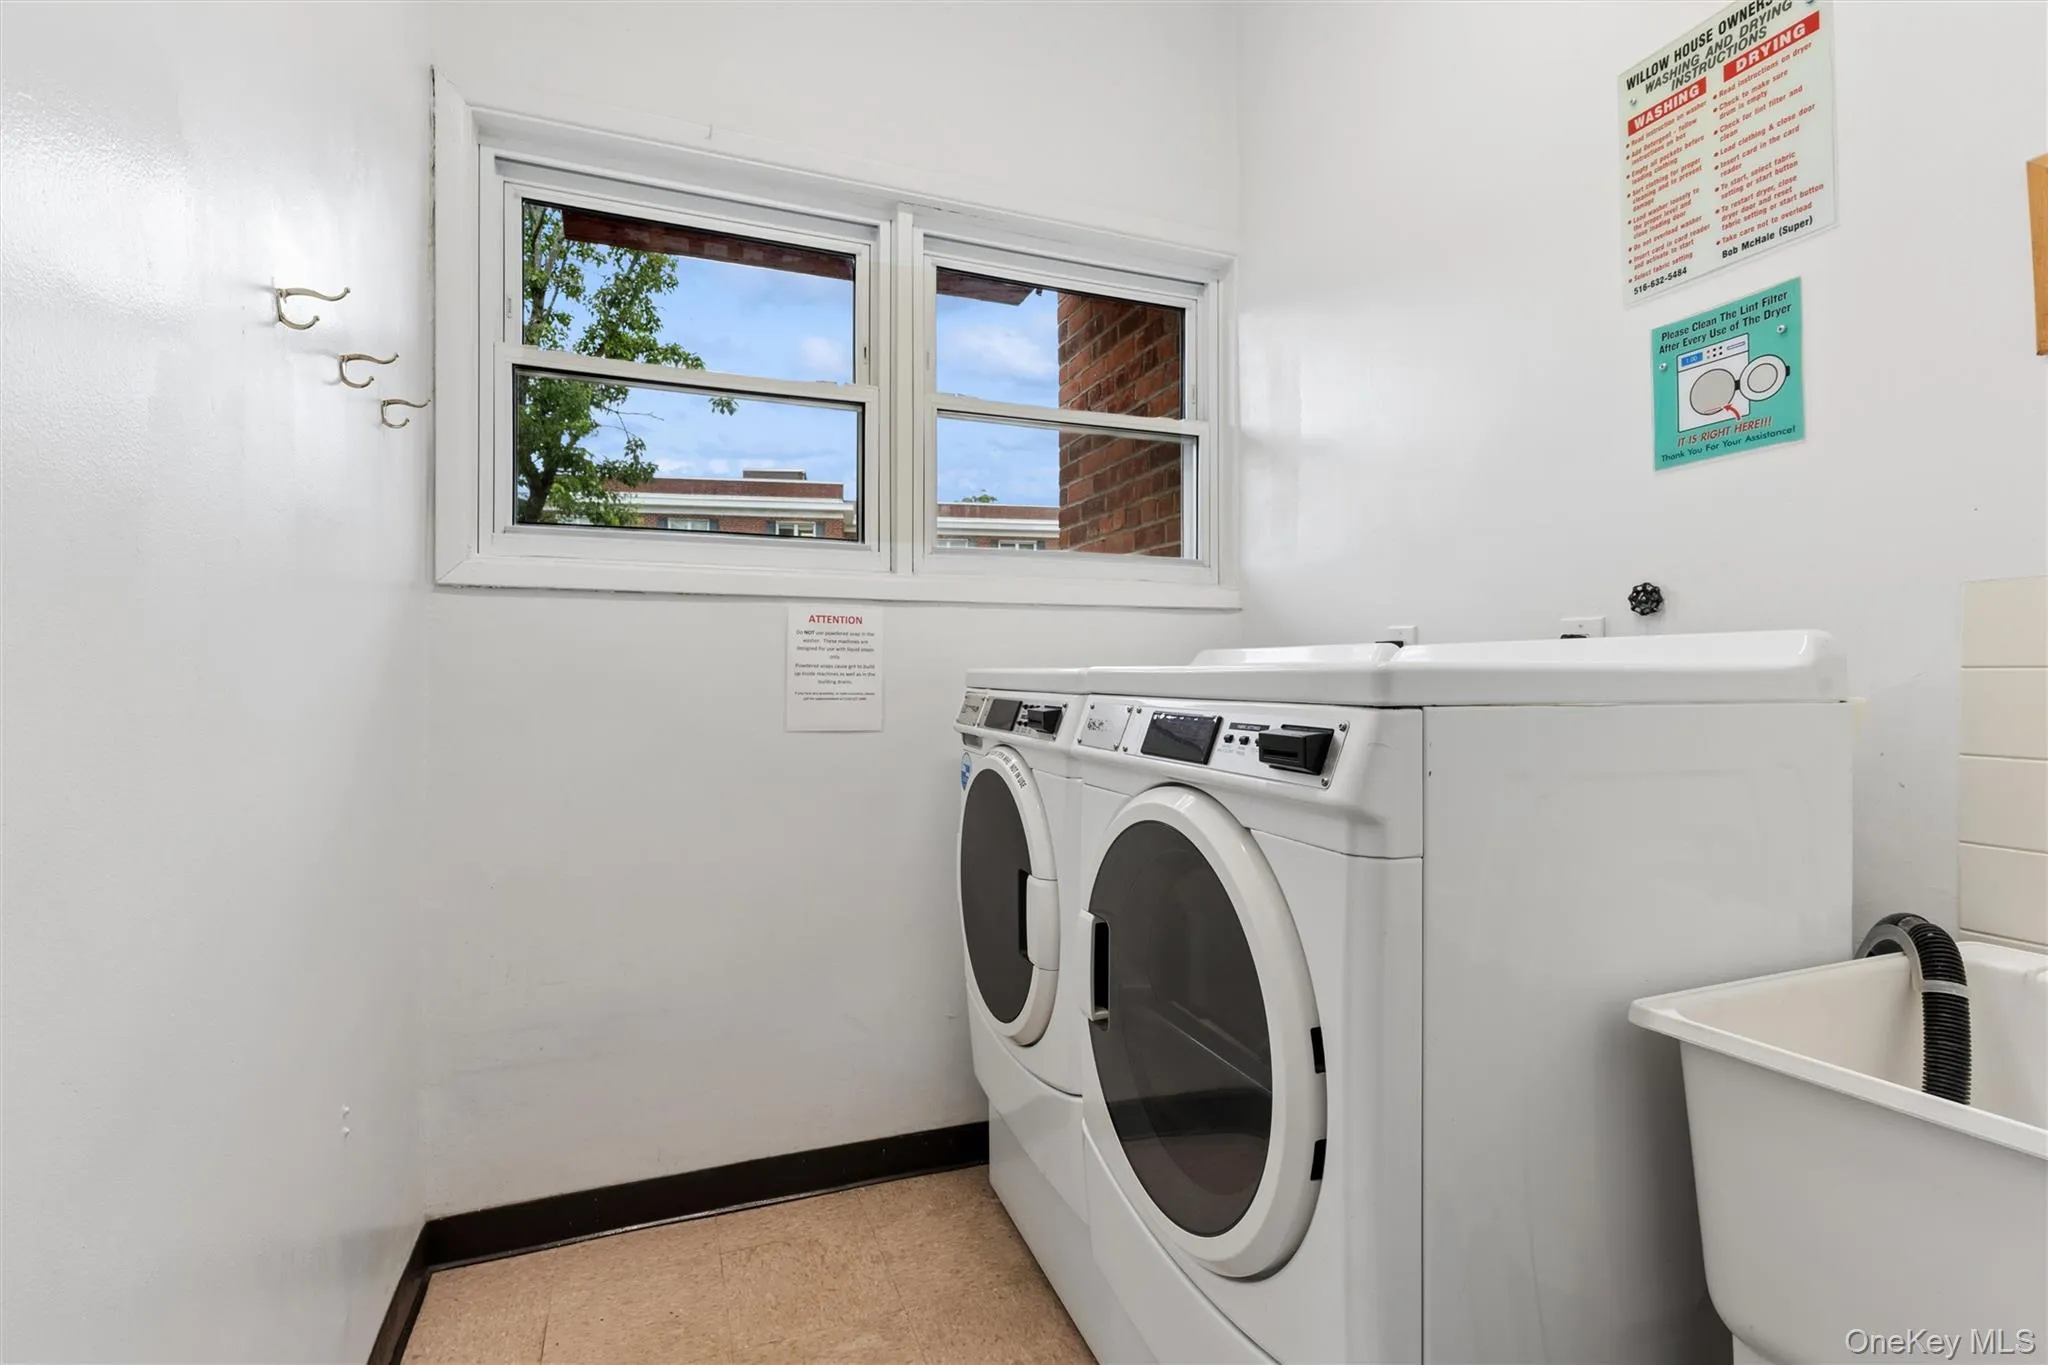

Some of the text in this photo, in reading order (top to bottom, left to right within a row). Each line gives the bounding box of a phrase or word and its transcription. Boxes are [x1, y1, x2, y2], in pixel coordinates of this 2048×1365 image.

[1626, 53, 1669, 92] WILLOW
[1674, 26, 1713, 63] HOUSE
[1645, 0, 1792, 94] WASHING AND DRYING
[1671, 24, 1767, 91] INSTRUCTIONS
[1735, 20, 1805, 73] DRYING
[1718, 40, 1811, 97] Read instructions on dryer
[1719, 68, 1787, 111] Check to make sure
[1633, 82, 1699, 131] WASHING
[1719, 90, 1767, 120] drum is empty
[1719, 83, 1802, 133] Check for lint filter and
[1719, 127, 1737, 142] clean
[1720, 101, 1815, 155] Load clothing & close door
[1720, 123, 1799, 168] Insert card in the card
[1631, 163, 1647, 178] Empty
[1659, 145, 1682, 163] pockets
[1684, 134, 1704, 150] before
[1632, 156, 1677, 186] loading clothing
[1632, 156, 1700, 197] Sort clothing for proper
[1720, 161, 1741, 177] reader
[1720, 149, 1795, 191] To start, select fabric
[1632, 164, 1701, 204] cleaning and to prevent
[1720, 183, 1743, 201] setting
[1755, 170, 1771, 184] start
[1774, 158, 1797, 175] button
[1721, 173, 1796, 213] To restart dryer, close
[1632, 197, 1654, 212] damage
[1633, 199, 1691, 232] the proper level and
[1721, 185, 1792, 223] dryer door and reset
[1721, 181, 1823, 231] fabric setting or start button
[1722, 200, 1812, 244] Take care not to overload
[1633, 214, 1701, 250] Do not overload washer
[1633, 250, 1649, 262] Insert
[1651, 243, 1664, 254] card
[1674, 233, 1688, 244] card
[1690, 223, 1710, 237] reader
[1722, 214, 1813, 258] Bob McHale (Super)
[1634, 238, 1693, 269] and activate to start
[1634, 251, 1692, 281] Select fabric setting
[1659, 301, 1791, 355] After Every Use of The Dryer
[1661, 289, 1787, 342] Please Clean The Lint Filter
[1661, 424, 1795, 462] Thank You For Your Assistance!
[1678, 416, 1772, 447] IT IS RIGHT HERE!!!
[808, 615, 863, 625] ATTENTION
